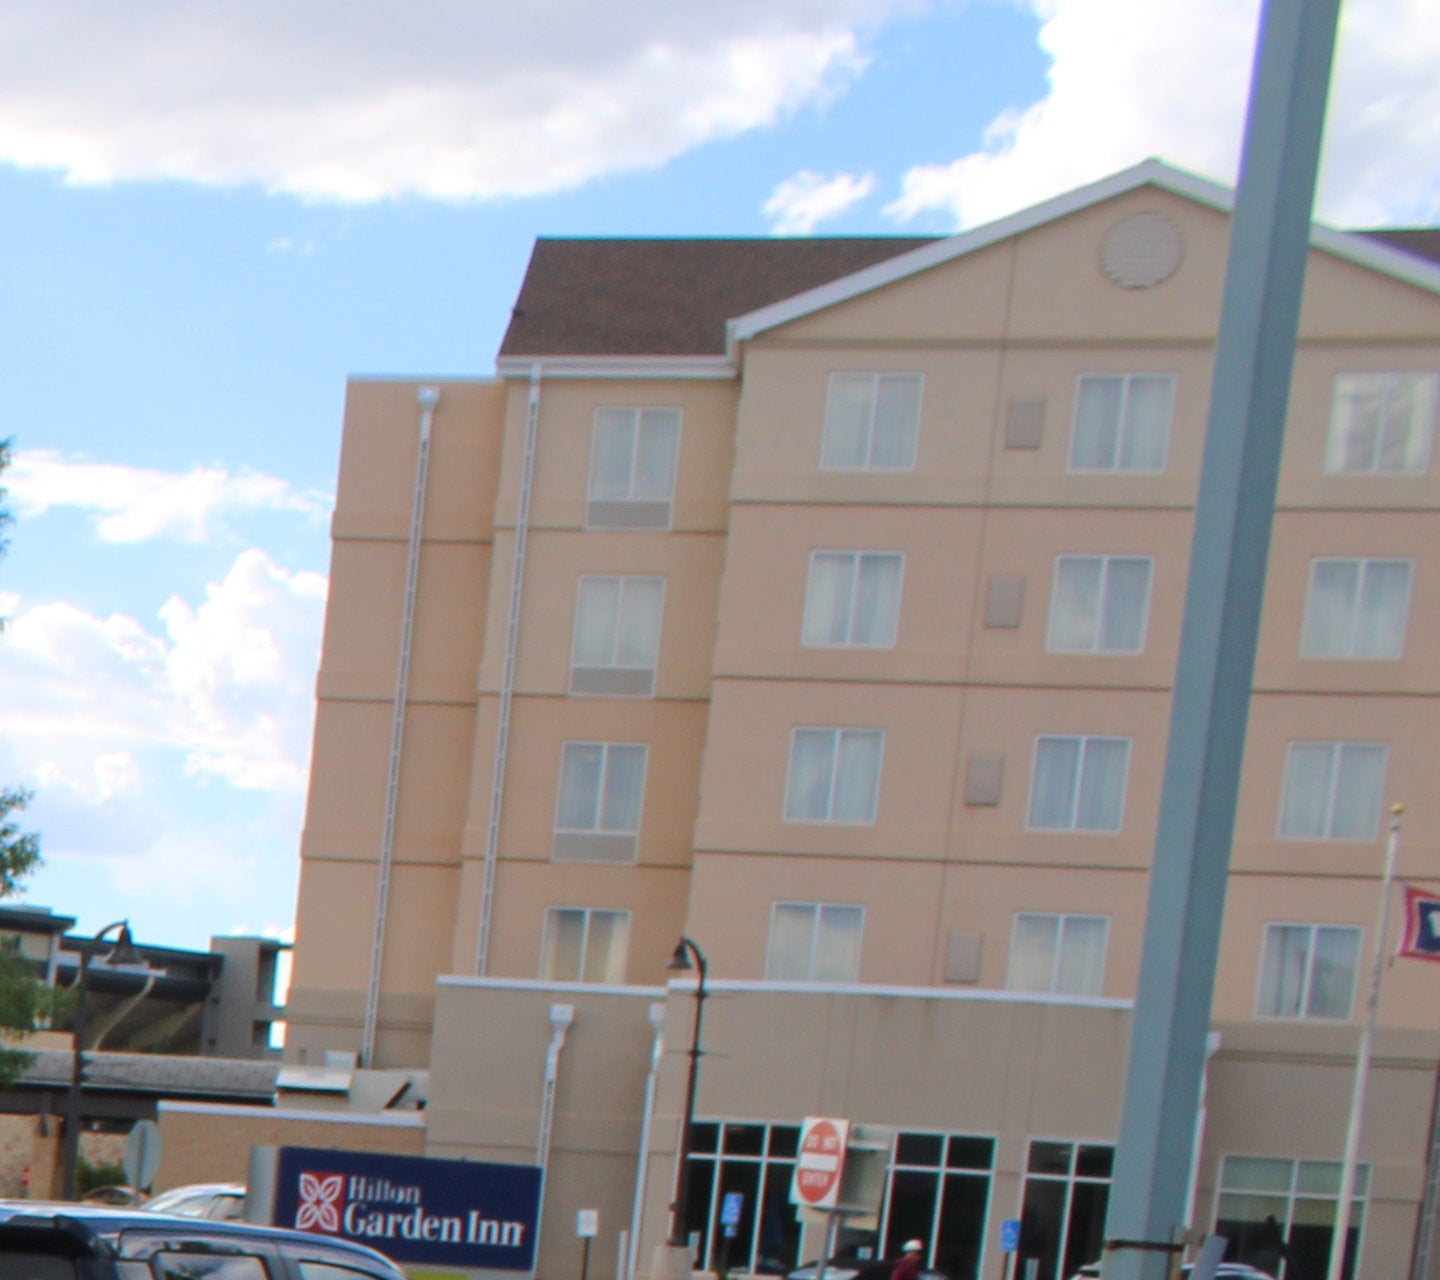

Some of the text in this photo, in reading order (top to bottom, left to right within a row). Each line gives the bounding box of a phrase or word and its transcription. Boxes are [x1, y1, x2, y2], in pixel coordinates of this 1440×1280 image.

[347, 1175, 422, 1204] Hilton
[343, 1202, 525, 1247] Garden Inn
